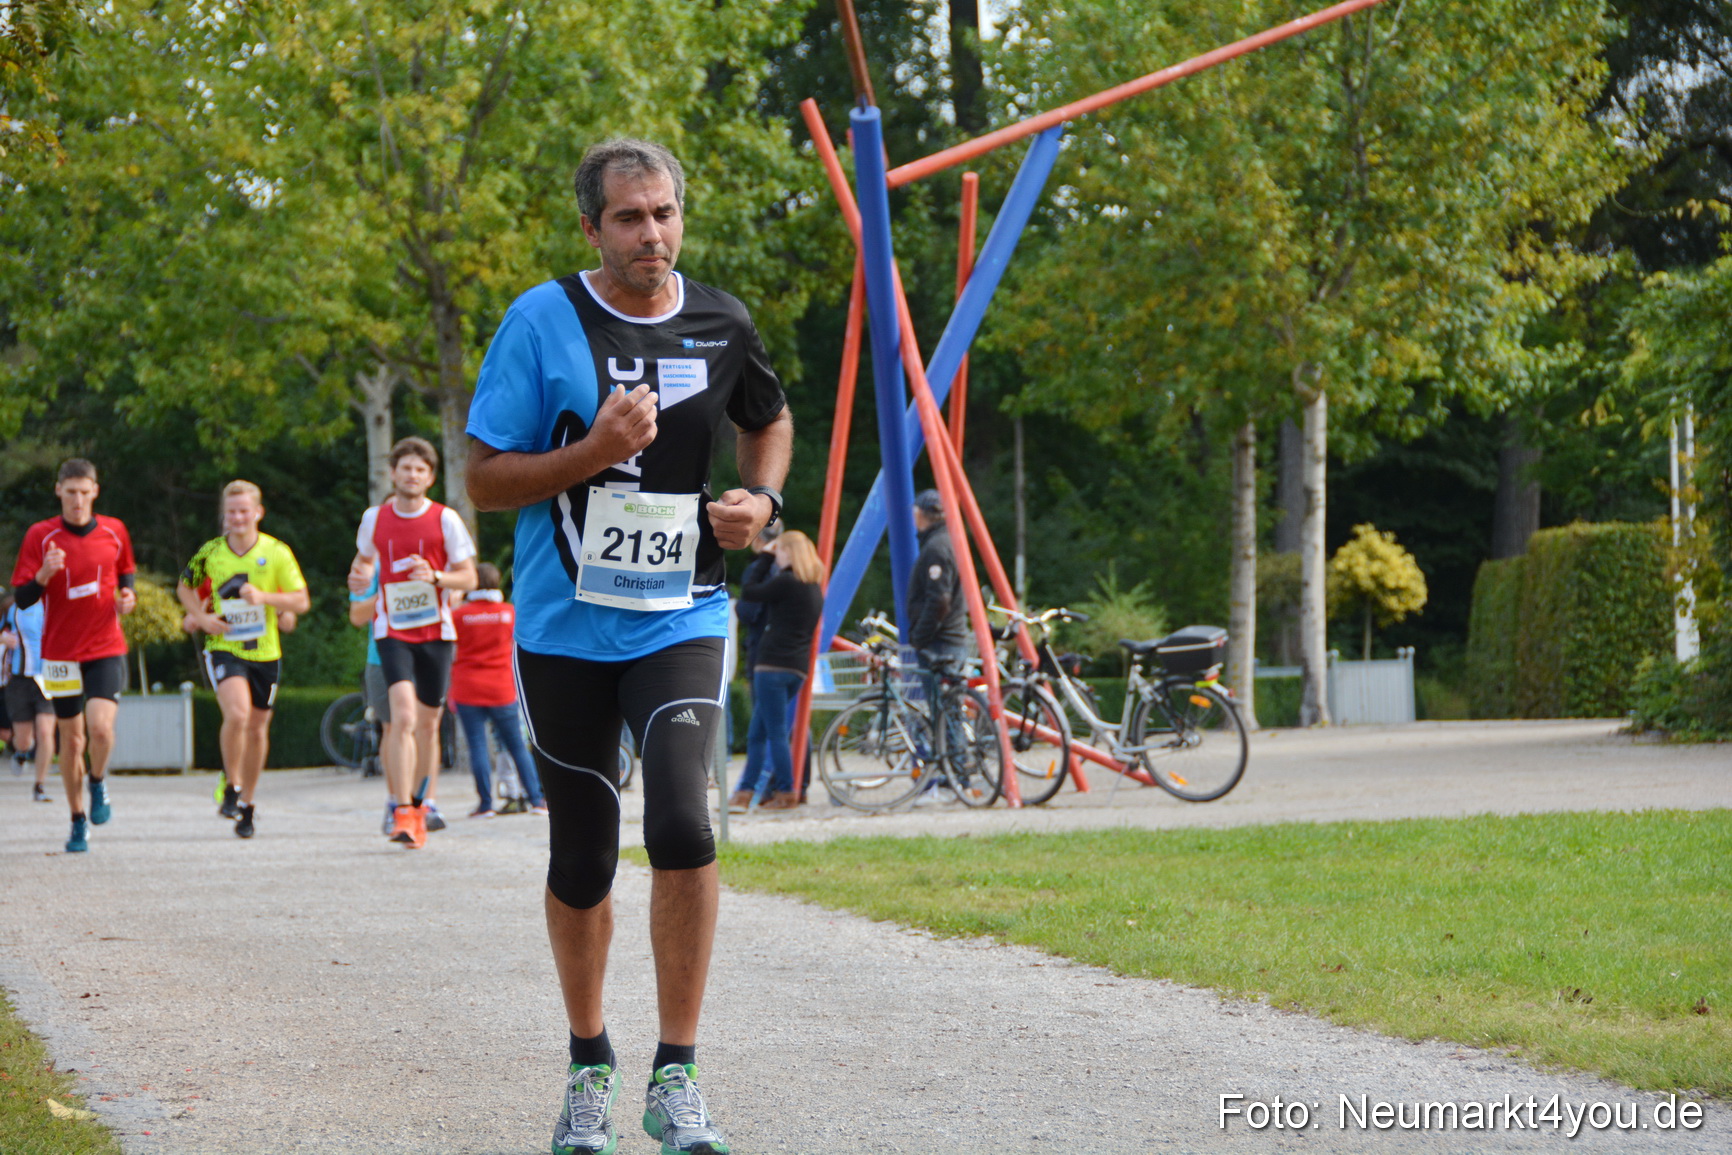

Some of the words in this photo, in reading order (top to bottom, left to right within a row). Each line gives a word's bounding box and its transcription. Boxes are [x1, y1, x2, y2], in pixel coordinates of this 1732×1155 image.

[636, 504, 676, 515] BOCK
[600, 526, 683, 566] 2134
[613, 574, 665, 590] Christian
[394, 592, 429, 612] 2092
[671, 717, 700, 726] adidas
